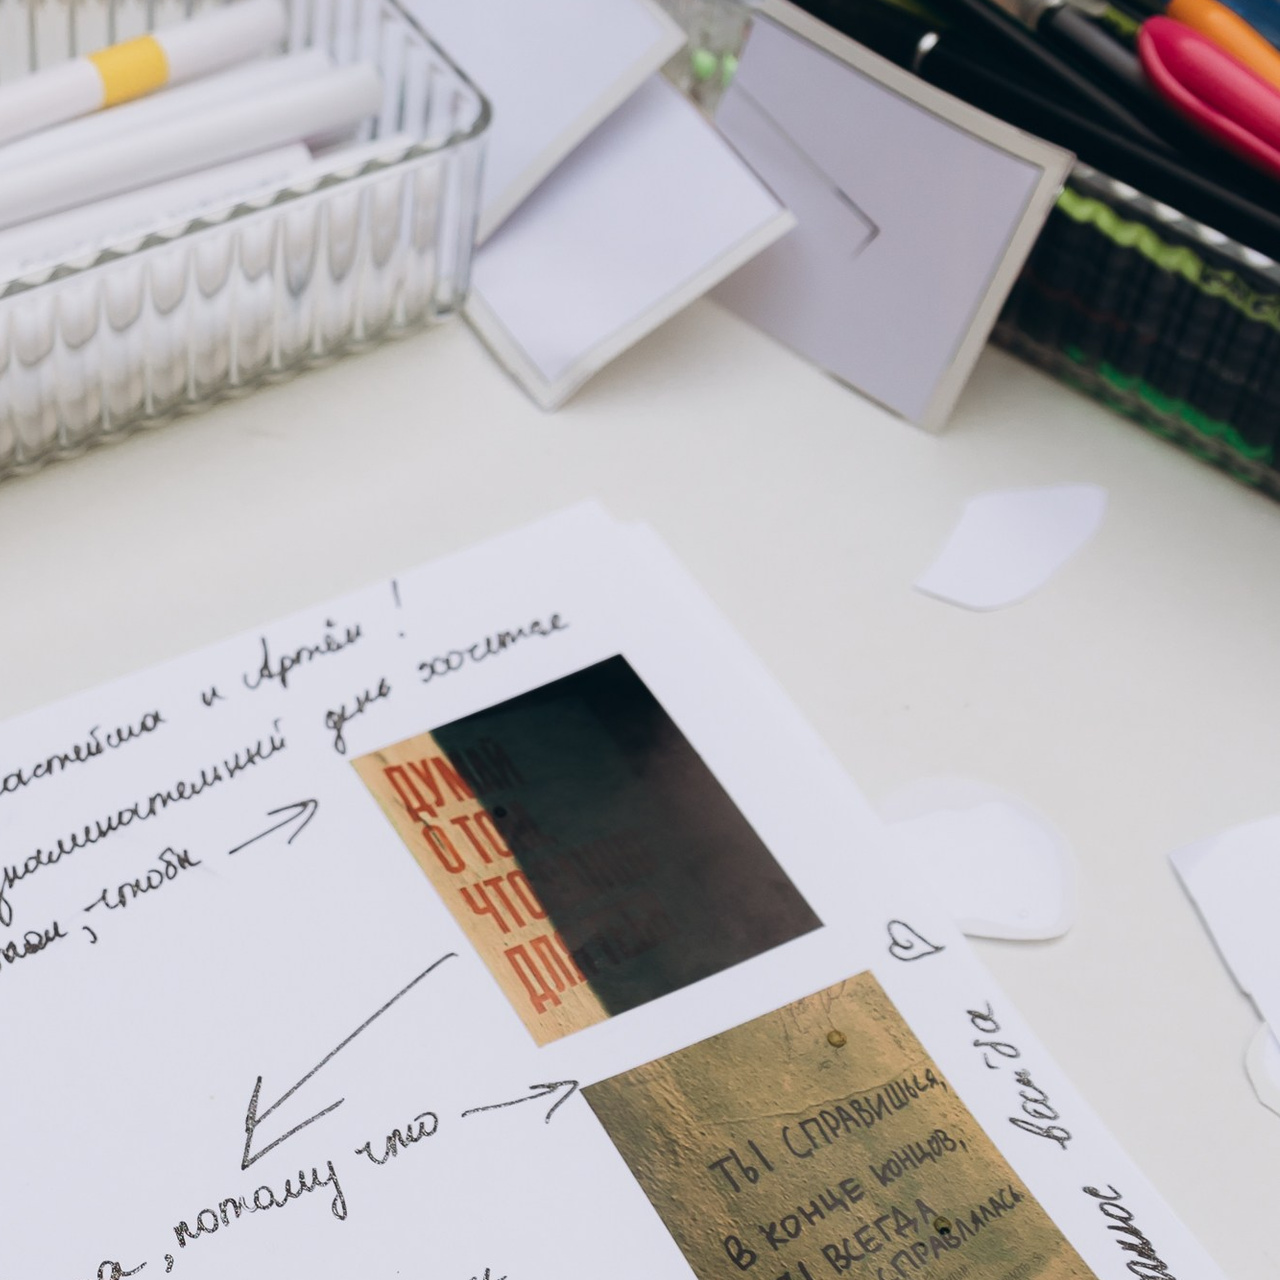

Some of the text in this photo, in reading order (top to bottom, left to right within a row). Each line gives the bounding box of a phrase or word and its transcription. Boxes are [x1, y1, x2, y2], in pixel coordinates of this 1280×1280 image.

[202, 684, 226, 708] и
[324, 677, 393, 755] день
[421, 823, 467, 875] О
[354, 1111, 441, 1167] что
[707, 1141, 773, 1194] ТЫ
[725, 1127, 969, 1272] В КОНЦЕ КОНЦОВ,
[824, 1198, 948, 1277] ВСЕГДА
